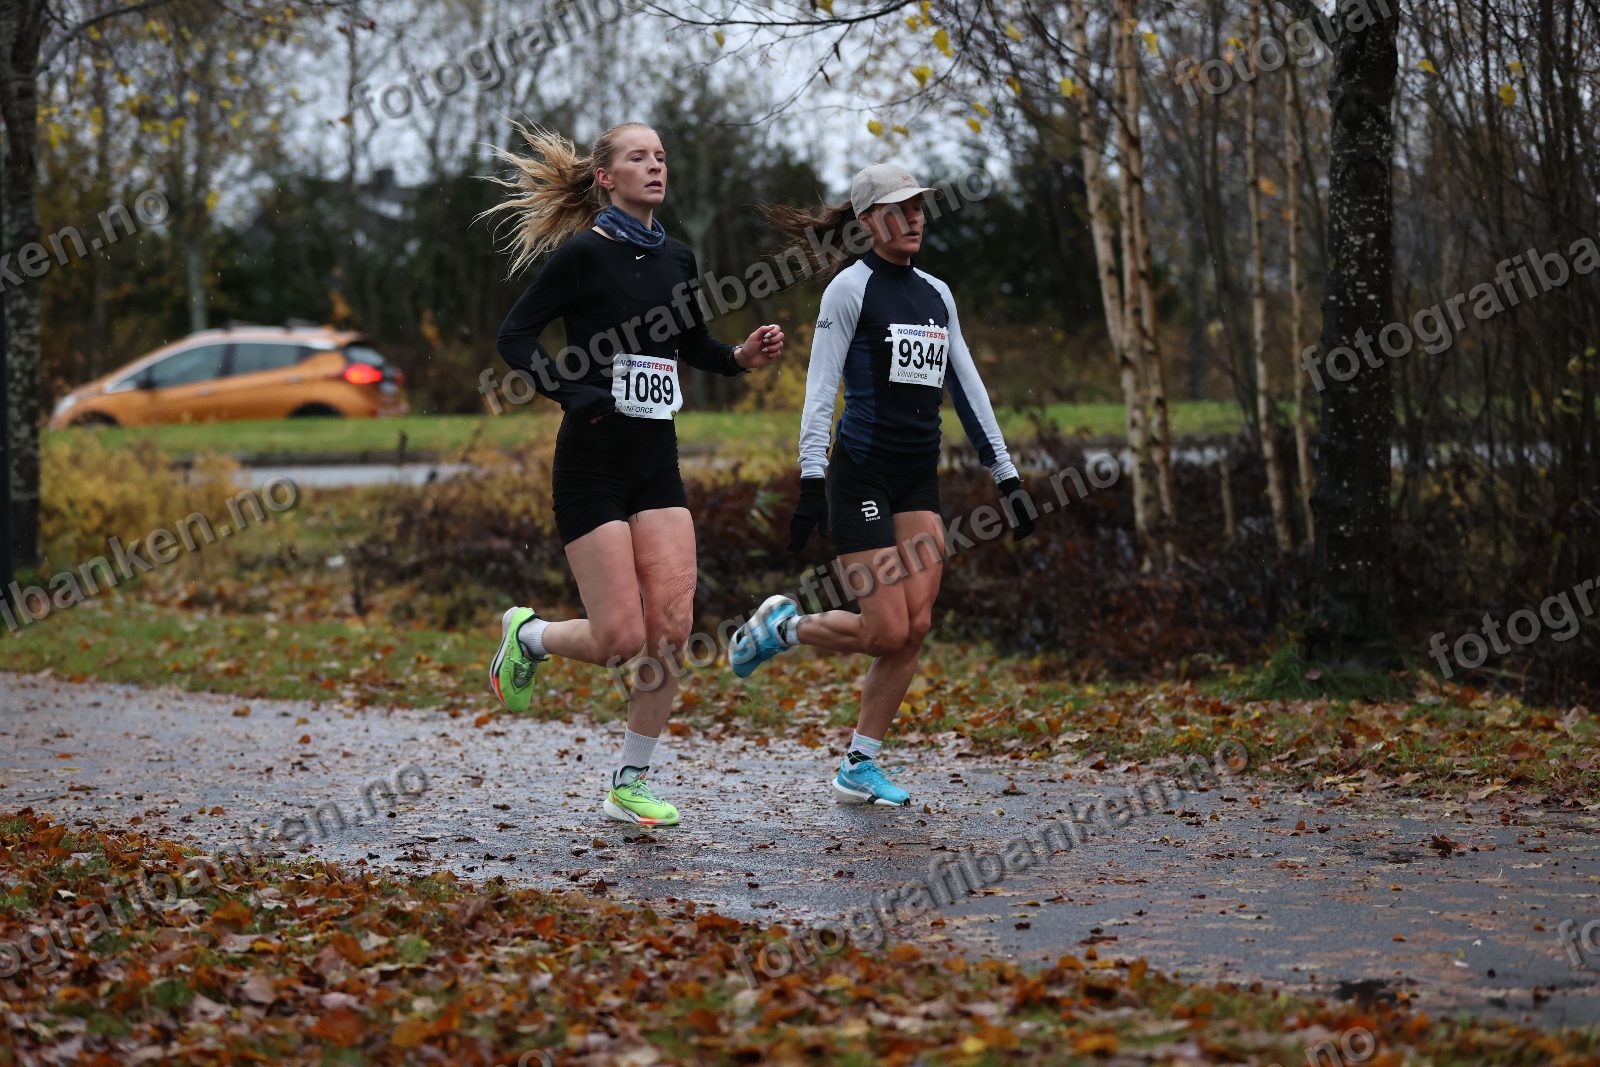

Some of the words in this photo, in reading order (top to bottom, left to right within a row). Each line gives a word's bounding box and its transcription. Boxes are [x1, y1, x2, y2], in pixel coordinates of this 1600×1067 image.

[619, 360, 674, 373] NORGESTESTEN
[898, 338, 945, 373] 9344
[621, 371, 674, 406] 1089
